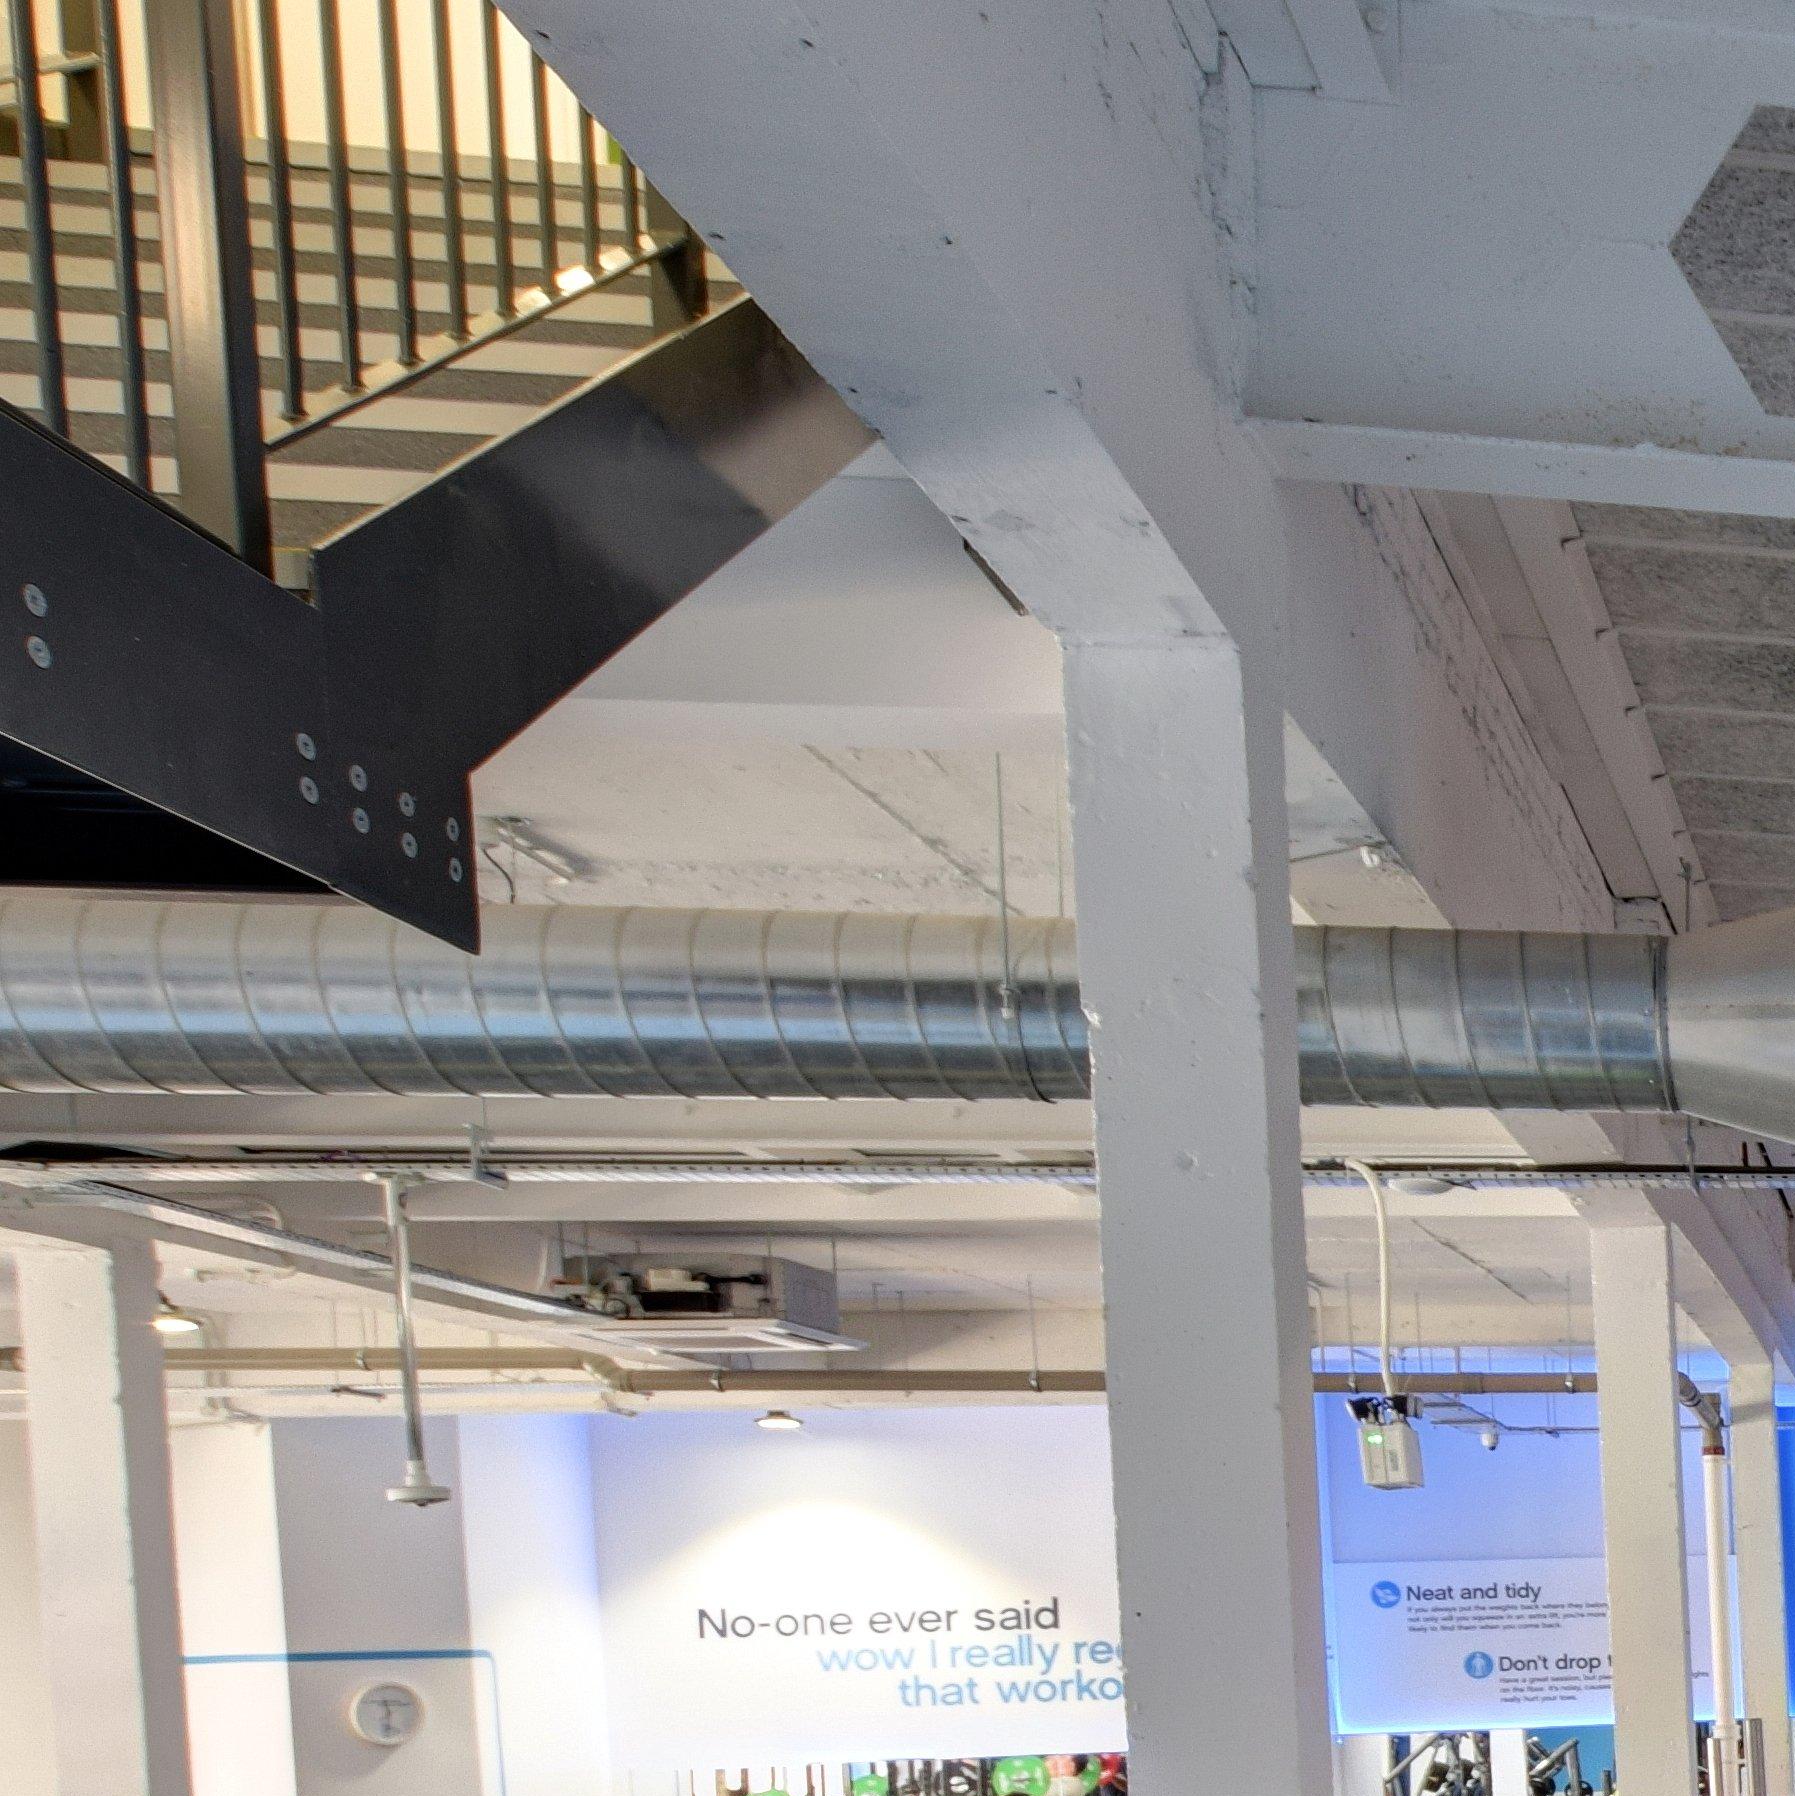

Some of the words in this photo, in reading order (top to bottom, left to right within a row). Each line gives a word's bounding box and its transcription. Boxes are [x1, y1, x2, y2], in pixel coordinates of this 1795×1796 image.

[1405, 1584, 1455, 1602] Neat
[1460, 1582, 1499, 1601] and
[1504, 1582, 1542, 1604] tidy
[697, 1608, 853, 1639] No-one
[868, 1608, 959, 1634] ever
[973, 1596, 1061, 1632] said
[815, 1646, 917, 1672] wow
[950, 1633, 1059, 1676] really
[1499, 1653, 1549, 1673] Don't
[1554, 1652, 1601, 1674] drop
[898, 1674, 980, 1708] that
[994, 1669, 1124, 1704] worko
